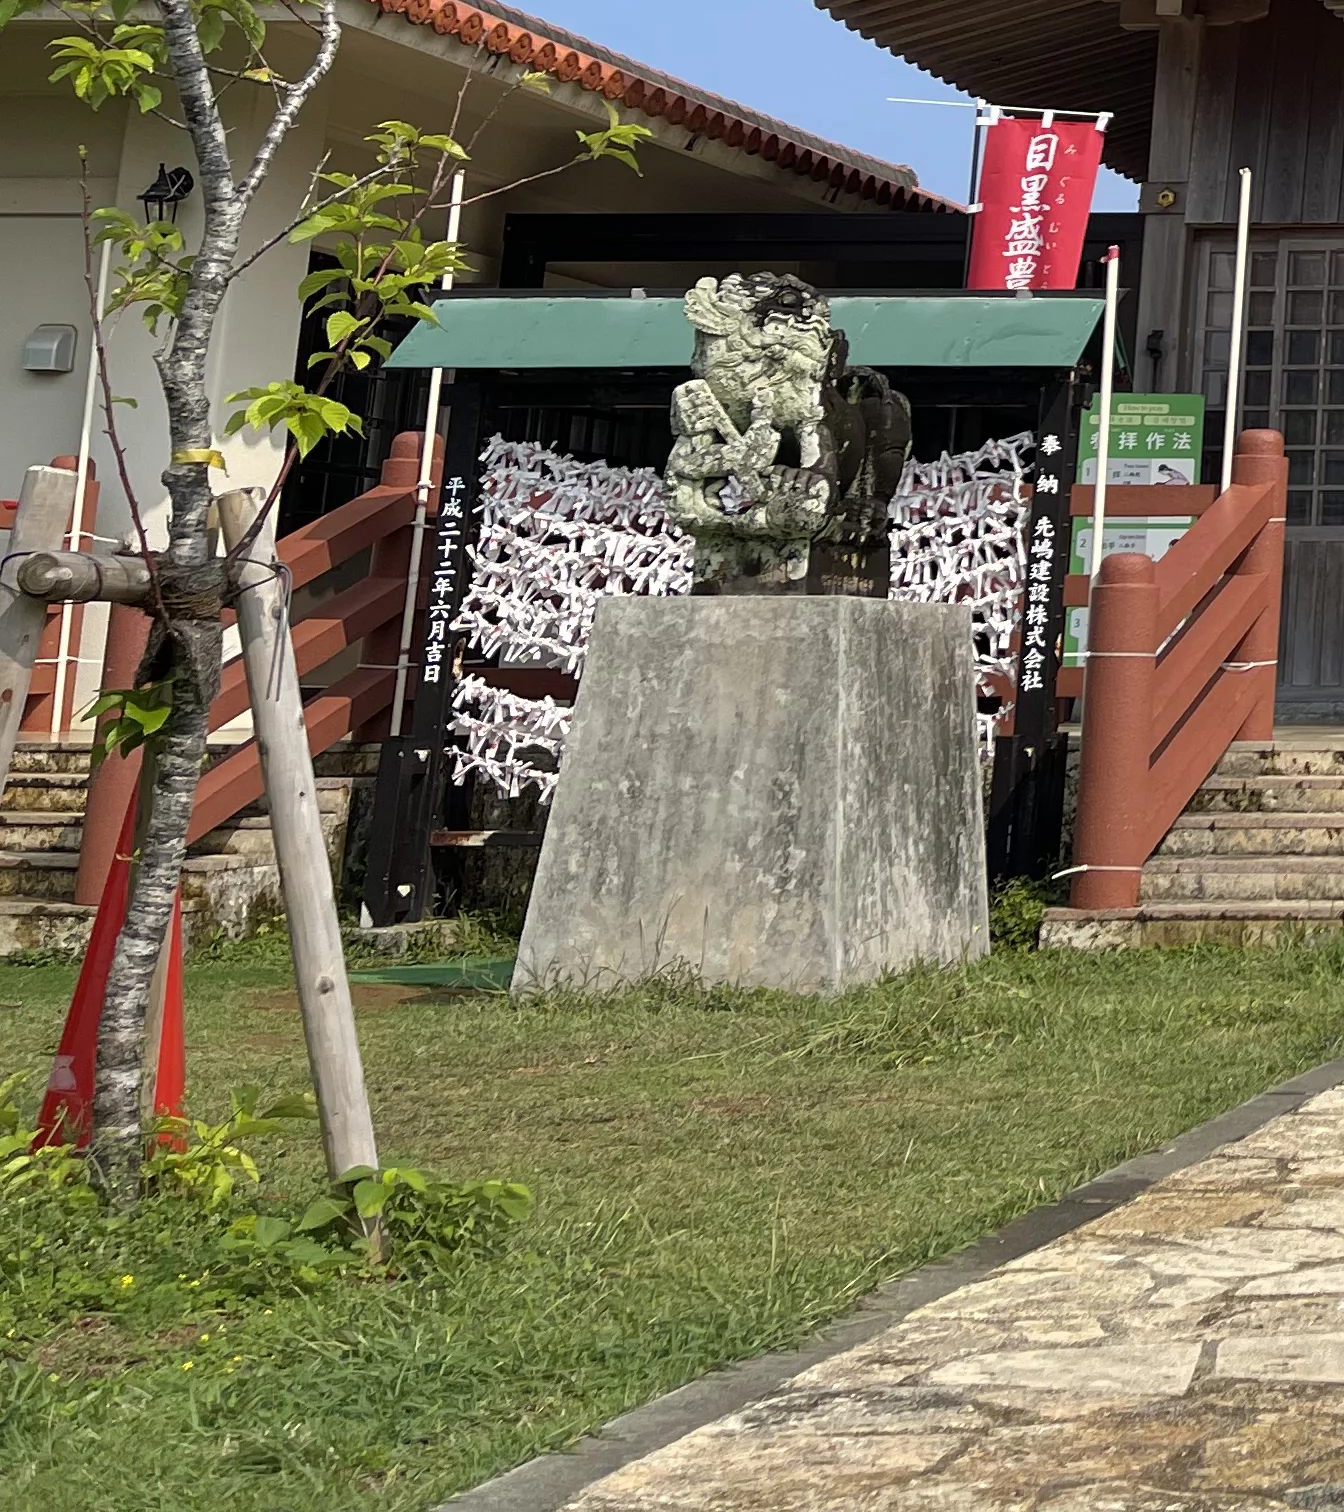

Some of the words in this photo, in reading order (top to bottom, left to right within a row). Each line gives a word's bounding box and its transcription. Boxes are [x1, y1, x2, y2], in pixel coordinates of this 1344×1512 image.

[1036, 434, 1062, 495] 奉納
[1079, 538, 1086, 548] 2
[424, 476, 466, 683] 平成二十二年六月吉日
[1021, 515, 1056, 692] 先嶋建設株式会社
[1073, 618, 1081, 629] 3
